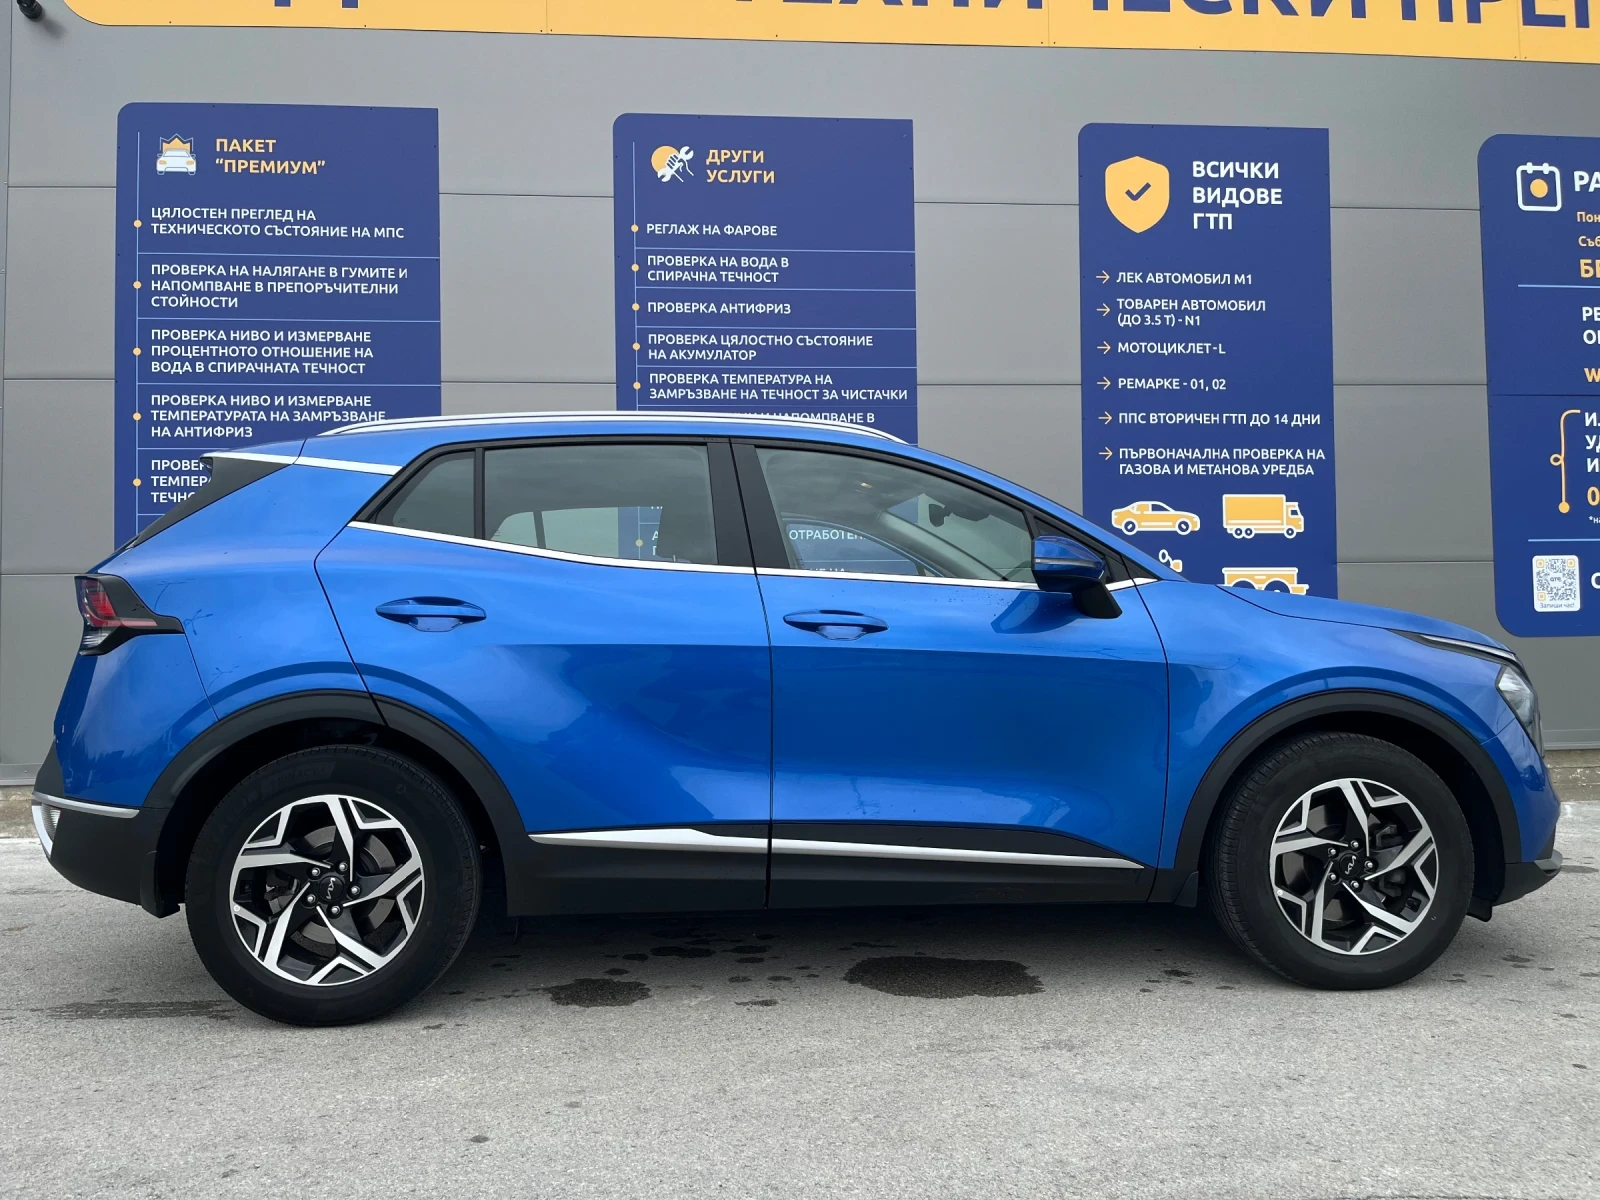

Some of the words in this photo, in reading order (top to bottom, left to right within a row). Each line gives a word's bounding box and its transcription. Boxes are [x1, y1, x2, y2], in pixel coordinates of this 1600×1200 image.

[217, 139, 276, 152] ПАКЕТ
[706, 150, 763, 165] ДРУГИ
[1193, 161, 1278, 178] ВСИЧКИ
[707, 170, 774, 183] УСЛУГИ
[1193, 187, 1282, 207] ВИДОВЕ
[152, 208, 226, 220] ЦЯЛОСТЕН
[232, 209, 293, 222] ПРЕГЛЕД
[297, 210, 316, 220] НА
[1194, 213, 1232, 229] ГТП
[151, 224, 260, 235] ТЕХНИЧЕСКОТО
[265, 225, 348, 237] СЪСТОЯНИЕ
[352, 227, 370, 237] НА
[374, 228, 404, 238] МПС
[647, 224, 699, 234] РЕГЛАЖ
[703, 225, 720, 235] НА
[724, 225, 777, 235] ФАРОВЕ
[648, 256, 717, 266] ПРОВЕРКА
[720, 257, 738, 267] НА
[741, 257, 777, 269] ВОДА
[781, 258, 789, 267] В
[152, 265, 226, 275] ПРОВЕРКА
[230, 266, 249, 275] НА
[253, 266, 325, 277] НАЛЯГАНЕ
[330, 267, 337, 277] В
[342, 268, 395, 278] ГУМИТЕ
[399, 268, 407, 278] И
[648, 271, 717, 281] СПИРАЧНА
[720, 272, 779, 282] ТЕЧНОСТ
[1117, 272, 1142, 283] ЛЕК
[1146, 273, 1230, 284] АВТОМОБИЛ
[152, 281, 251, 291] НАПОМПВАНЕ
[255, 282, 263, 292] В
[268, 282, 398, 294] ПРЕПОРЪЧИТЕЛНИ
[151, 294, 237, 307] СТОЙНОСТИ
[1117, 299, 1177, 309] ТОВАРЕН
[1182, 300, 1265, 311] АВТОМОБИЛ
[648, 302, 717, 313] ПРОВЕРКА
[720, 303, 791, 314] АНТИФРИЗ
[1118, 313, 1141, 327] (ДО
[1144, 315, 1161, 325] 3.5
[1185, 316, 1199, 325] N1
[152, 330, 226, 340] ПРОВЕРКА
[231, 331, 270, 341] НИВО
[275, 331, 283, 341] И
[288, 331, 371, 342] ИЗМЕРВАНЕ
[649, 334, 717, 344] ПРОВЕРКА
[721, 335, 793, 347] ЦЯЛОСТНО
[797, 336, 873, 345] СЪСТОЯНИЕ
[1583, 330, 1600, 344] О
[152, 346, 257, 358] ПРОЦЕНТНОТО
[262, 347, 351, 357] ОТНОШЕНИЕ
[355, 348, 373, 357] НА
[649, 349, 666, 359] НА
[670, 350, 756, 360] АКУМУЛАТОР
[152, 362, 192, 374] ВОДА
[196, 362, 204, 372] В
[208, 362, 299, 373] СПИРАЧНАТА
[303, 363, 365, 373] ТЕЧНОСТ
[650, 374, 719, 384] ПРОВЕРКА
[722, 374, 812, 384] ТЕМПЕРАТУРА
[815, 375, 832, 384] НА
[1119, 378, 1180, 389] РЕМАРКЕ
[650, 389, 737, 399] ЗАМРЪЗВАНЕ
[741, 389, 758, 399] НА
[761, 390, 819, 399] ТЕЧНОСТ
[823, 390, 838, 399] ЗА
[842, 390, 907, 399] ЧИСТАЧКИ
[152, 395, 227, 405] ПРОВЕРКА
[231, 396, 270, 406] НИВО
[275, 396, 283, 405] И
[289, 396, 371, 406] ИЗМЕРВАНЕ
[151, 411, 266, 421] ТЕМПЕРАТУРАТА
[271, 411, 289, 421] НА
[293, 411, 385, 422] ЗАМРЪЗВАНЕ
[867, 412, 875, 423] В
[1119, 413, 1146, 423] ППС
[1150, 413, 1219, 424] ВТОРИЧЕН
[1223, 414, 1246, 424] ГТП
[1250, 414, 1270, 426] ДО
[1274, 414, 1288, 424] 14
[1291, 414, 1320, 427] ДНИ
[152, 427, 171, 437] НА
[174, 426, 252, 437] АНТИФРИЗ
[1120, 448, 1229, 459] ПЪРВОНАЧАЛНА
[1234, 449, 1303, 459] ПРОВЕРКА
[1307, 449, 1325, 459] НА
[1120, 464, 1171, 474] ГАЗОВА
[1175, 464, 1183, 474] И
[1187, 464, 1259, 474] МЕТАНОВА
[1263, 465, 1314, 477] УРЕДБА
[150, 476, 211, 486] ТЕМПЕР
